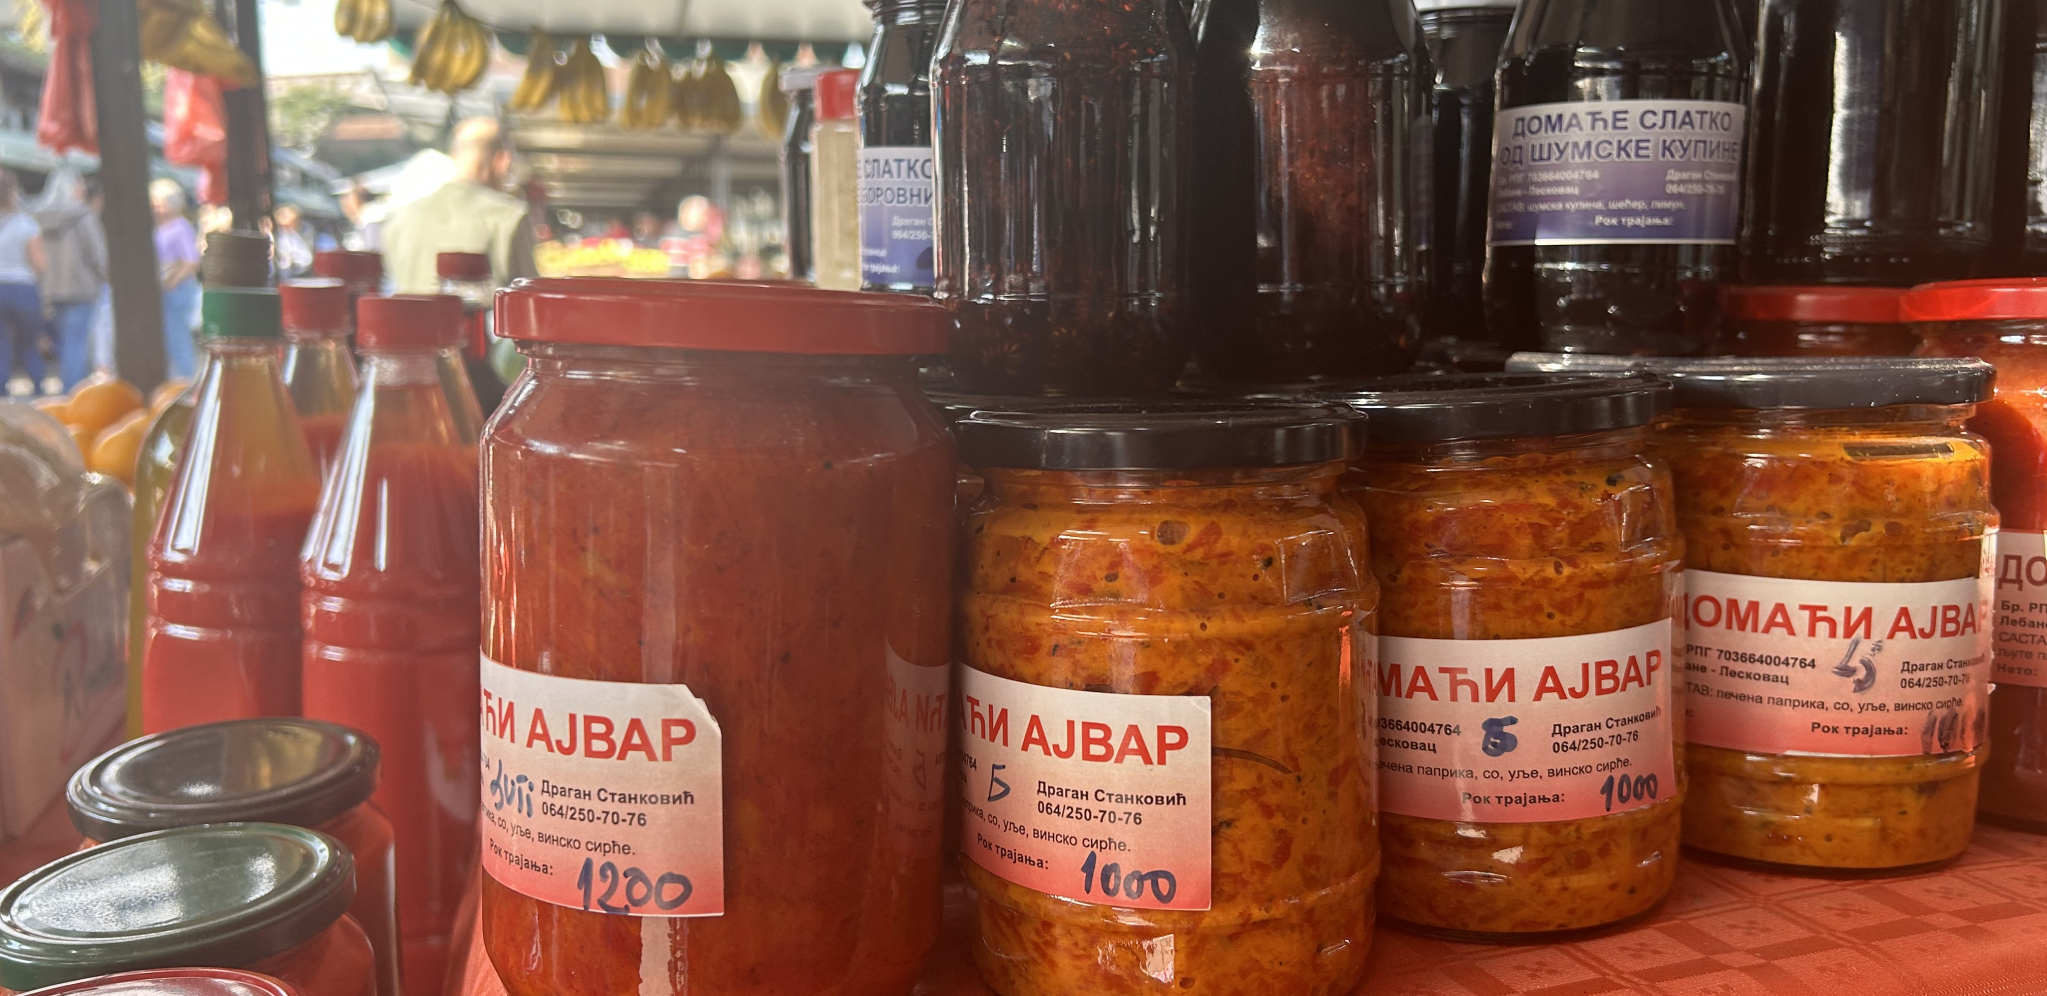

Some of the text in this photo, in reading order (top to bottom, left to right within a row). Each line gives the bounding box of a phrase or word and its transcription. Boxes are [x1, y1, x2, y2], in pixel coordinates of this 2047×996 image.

[1512, 109, 1732, 139] ДОМАЋЕ СЛАТКО
[1501, 139, 1739, 167] ОД ШУМСКЕ КУПИНЕ
[1527, 203, 1563, 213] шумска
[1595, 214, 1674, 228] Рок трајања:
[1686, 644, 1816, 670] РПГ 703664004764
[1901, 661, 1943, 675] Драган
[1997, 663, 2038, 677] Нето:
[1532, 649, 1662, 702] АЈВАР
[1719, 665, 1789, 686] Лесковац
[1716, 689, 1763, 704] печена
[1767, 694, 1829, 711] паприка,
[1834, 700, 1853, 712] со,
[1858, 700, 1890, 713] уље,
[1894, 698, 1933, 712] винско
[526, 706, 697, 763] АЈВАР
[1551, 721, 1602, 738] Драган
[1606, 705, 1662, 730] Станковић
[1811, 722, 1908, 736] Рок трајања:
[1021, 714, 1189, 766] АЈВАР
[1376, 737, 1437, 754] есковац
[1552, 729, 1639, 753] 064/250-70-76
[1417, 762, 1478, 781] паприка,
[1482, 767, 1503, 780] со,
[1508, 766, 1543, 782] уље,
[1547, 764, 1593, 778] винско
[1596, 755, 1632, 775] сирће.
[541, 779, 695, 806] Драган Станковић
[1037, 780, 1187, 807] Драган Станковић
[1462, 791, 1565, 807] Рок трајања:
[1600, 772, 1658, 812] 1000
[541, 804, 647, 828] 064/250-70-76
[1037, 801, 1142, 826] 064/250-70-76
[498, 817, 510, 832] со,
[511, 822, 534, 843] уље,
[538, 830, 582, 850] винско
[586, 841, 636, 857] сирће.
[988, 814, 1001, 830] со,
[1003, 819, 1029, 839] уље,
[1032, 828, 1077, 847] винско
[1082, 836, 1131, 853] сирће.
[489, 837, 554, 876] Рок трајања:
[977, 833, 1049, 871] Рок трајања:
[577, 857, 693, 915] 1200
[1081, 850, 1177, 904] 1000
